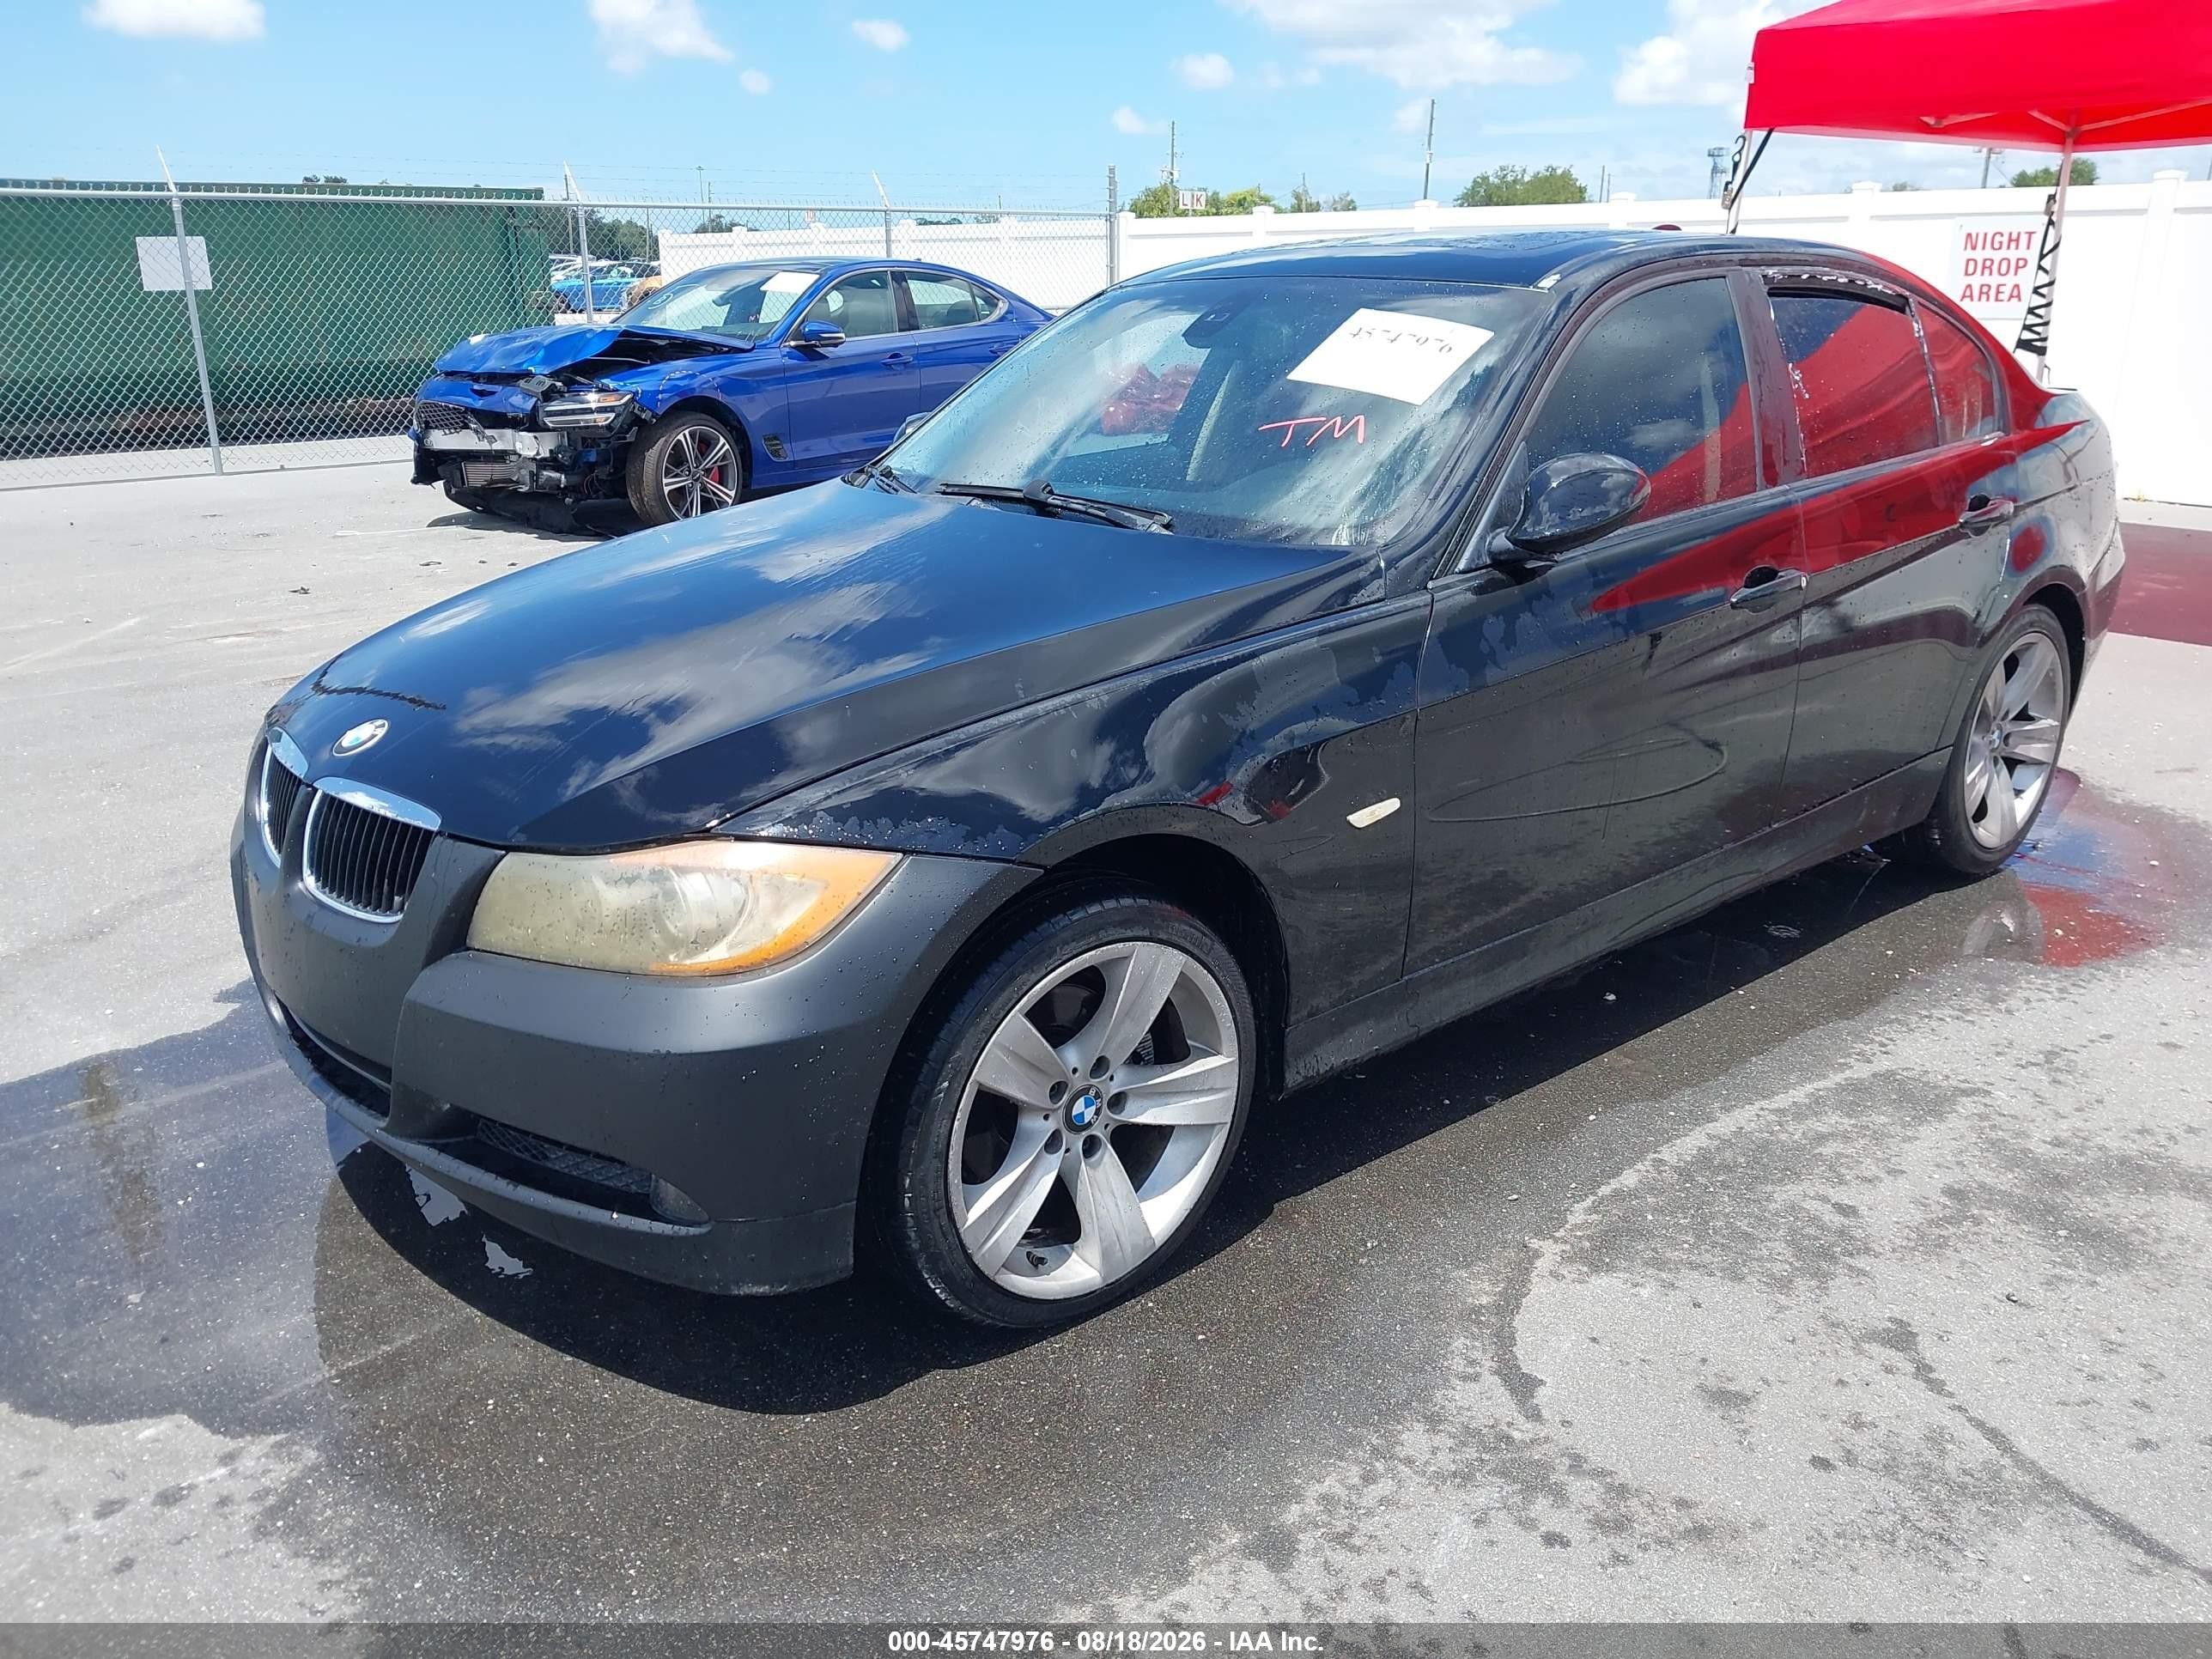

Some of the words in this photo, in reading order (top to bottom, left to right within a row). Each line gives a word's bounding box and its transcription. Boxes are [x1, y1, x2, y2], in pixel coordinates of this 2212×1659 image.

[1963, 231, 2037, 251] NIGHT
[1963, 258, 2028, 276] DROP
[1960, 283, 2022, 302] AREA
[1257, 414, 1365, 447] TM
